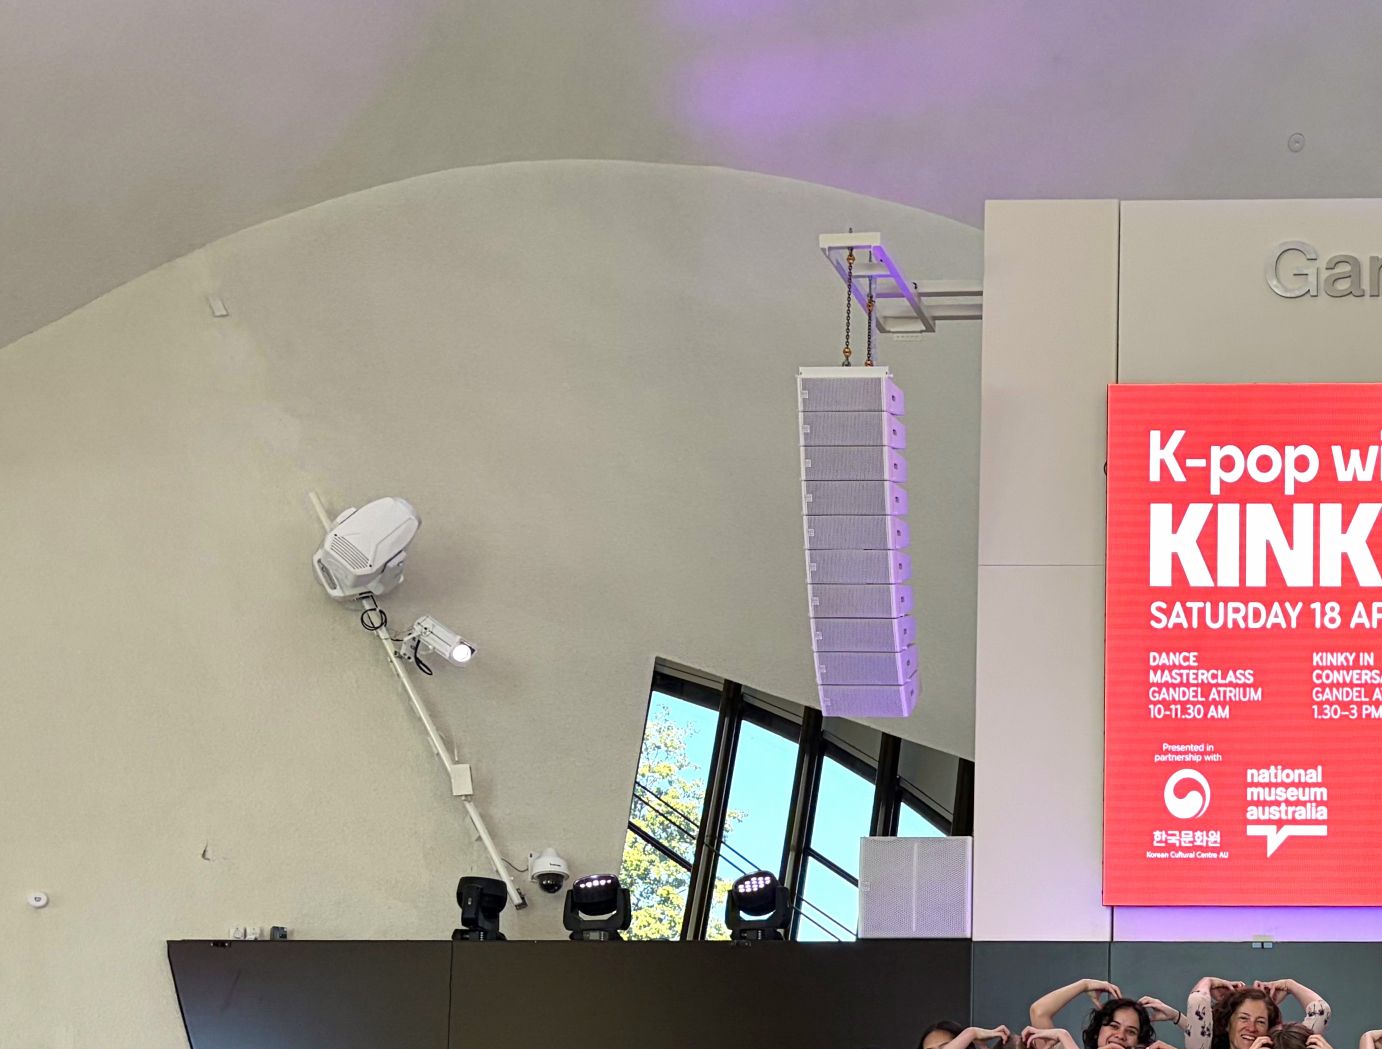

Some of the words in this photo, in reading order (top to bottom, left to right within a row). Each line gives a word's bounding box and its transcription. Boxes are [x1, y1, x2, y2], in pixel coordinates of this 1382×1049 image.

[1150, 430, 1319, 495] K-pop
[1151, 601, 1302, 628] SATURDAY
[1311, 602, 1341, 628] 18
[1150, 652, 1198, 666] DANCE
[1313, 653, 1355, 666] KINKY
[1360, 653, 1374, 665] IN
[1150, 670, 1253, 683] MASTERCLASS
[1149, 687, 1205, 701] GANDEL
[1209, 687, 1261, 701] ATRIUM
[1313, 688, 1369, 701] GANDEL
[1149, 705, 1204, 718] 10-11.30
[1208, 705, 1229, 718] AM
[1363, 705, 1382, 718] PM
[1162, 743, 1204, 752] Presented
[1206, 743, 1214, 752] in
[1154, 753, 1202, 763] partnership
[1204, 753, 1222, 762] with
[1247, 766, 1322, 783] national
[1247, 787, 1327, 801] museum
[1247, 803, 1327, 820] australia
[1154, 831, 1220, 846] 한국문화원
[1170, 851, 1195, 859] Cultural
